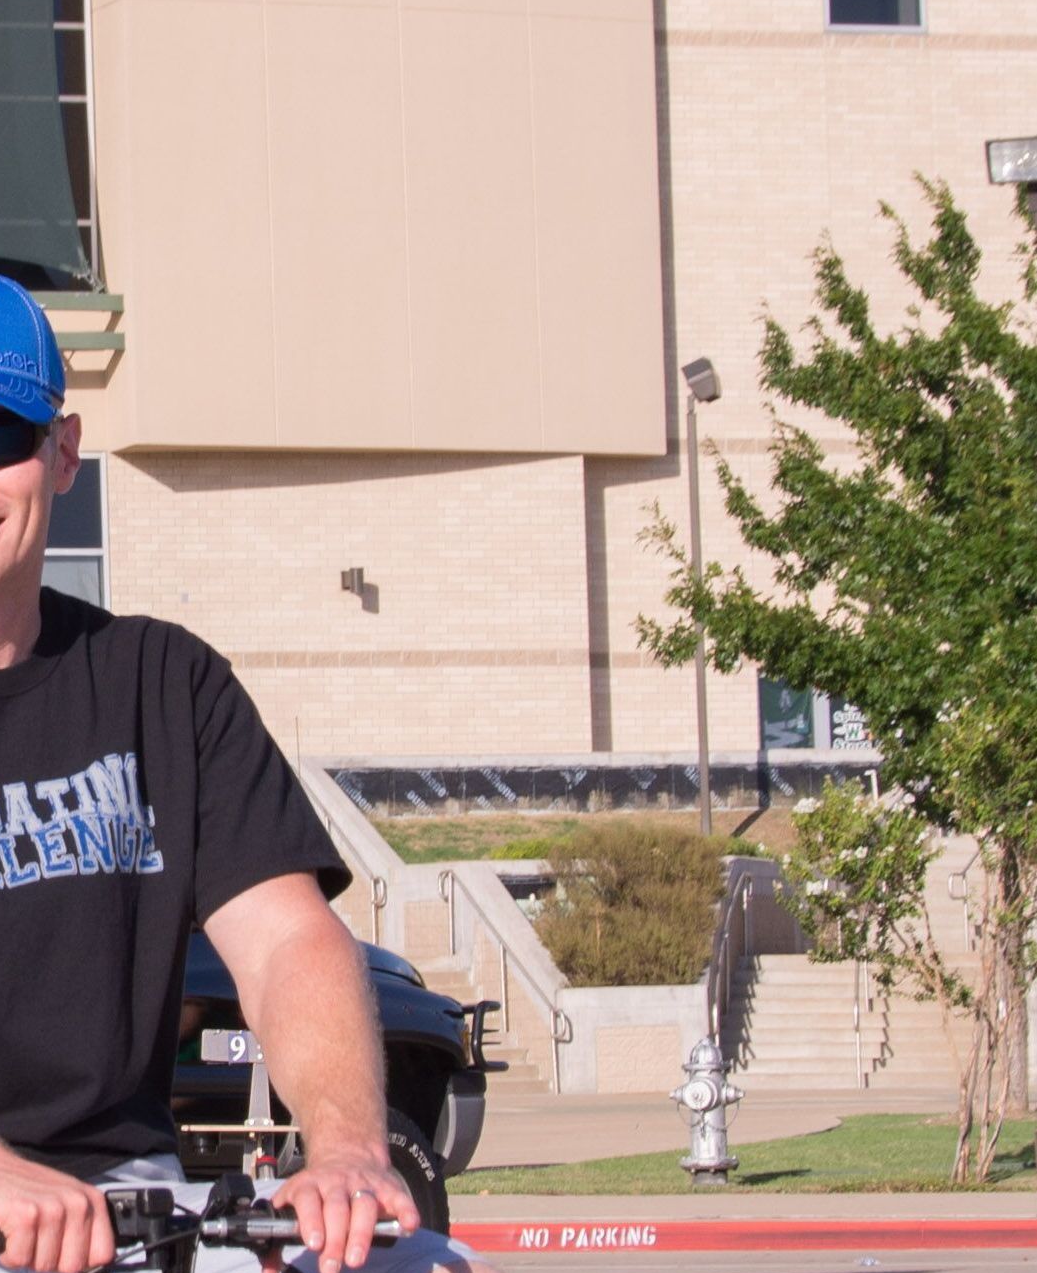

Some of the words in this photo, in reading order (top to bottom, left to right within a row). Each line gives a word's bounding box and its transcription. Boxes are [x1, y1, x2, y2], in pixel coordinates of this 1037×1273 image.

[230, 1035, 246, 1062] 9
[519, 1227, 549, 1247] NO
[561, 1226, 657, 1247] PARKING
